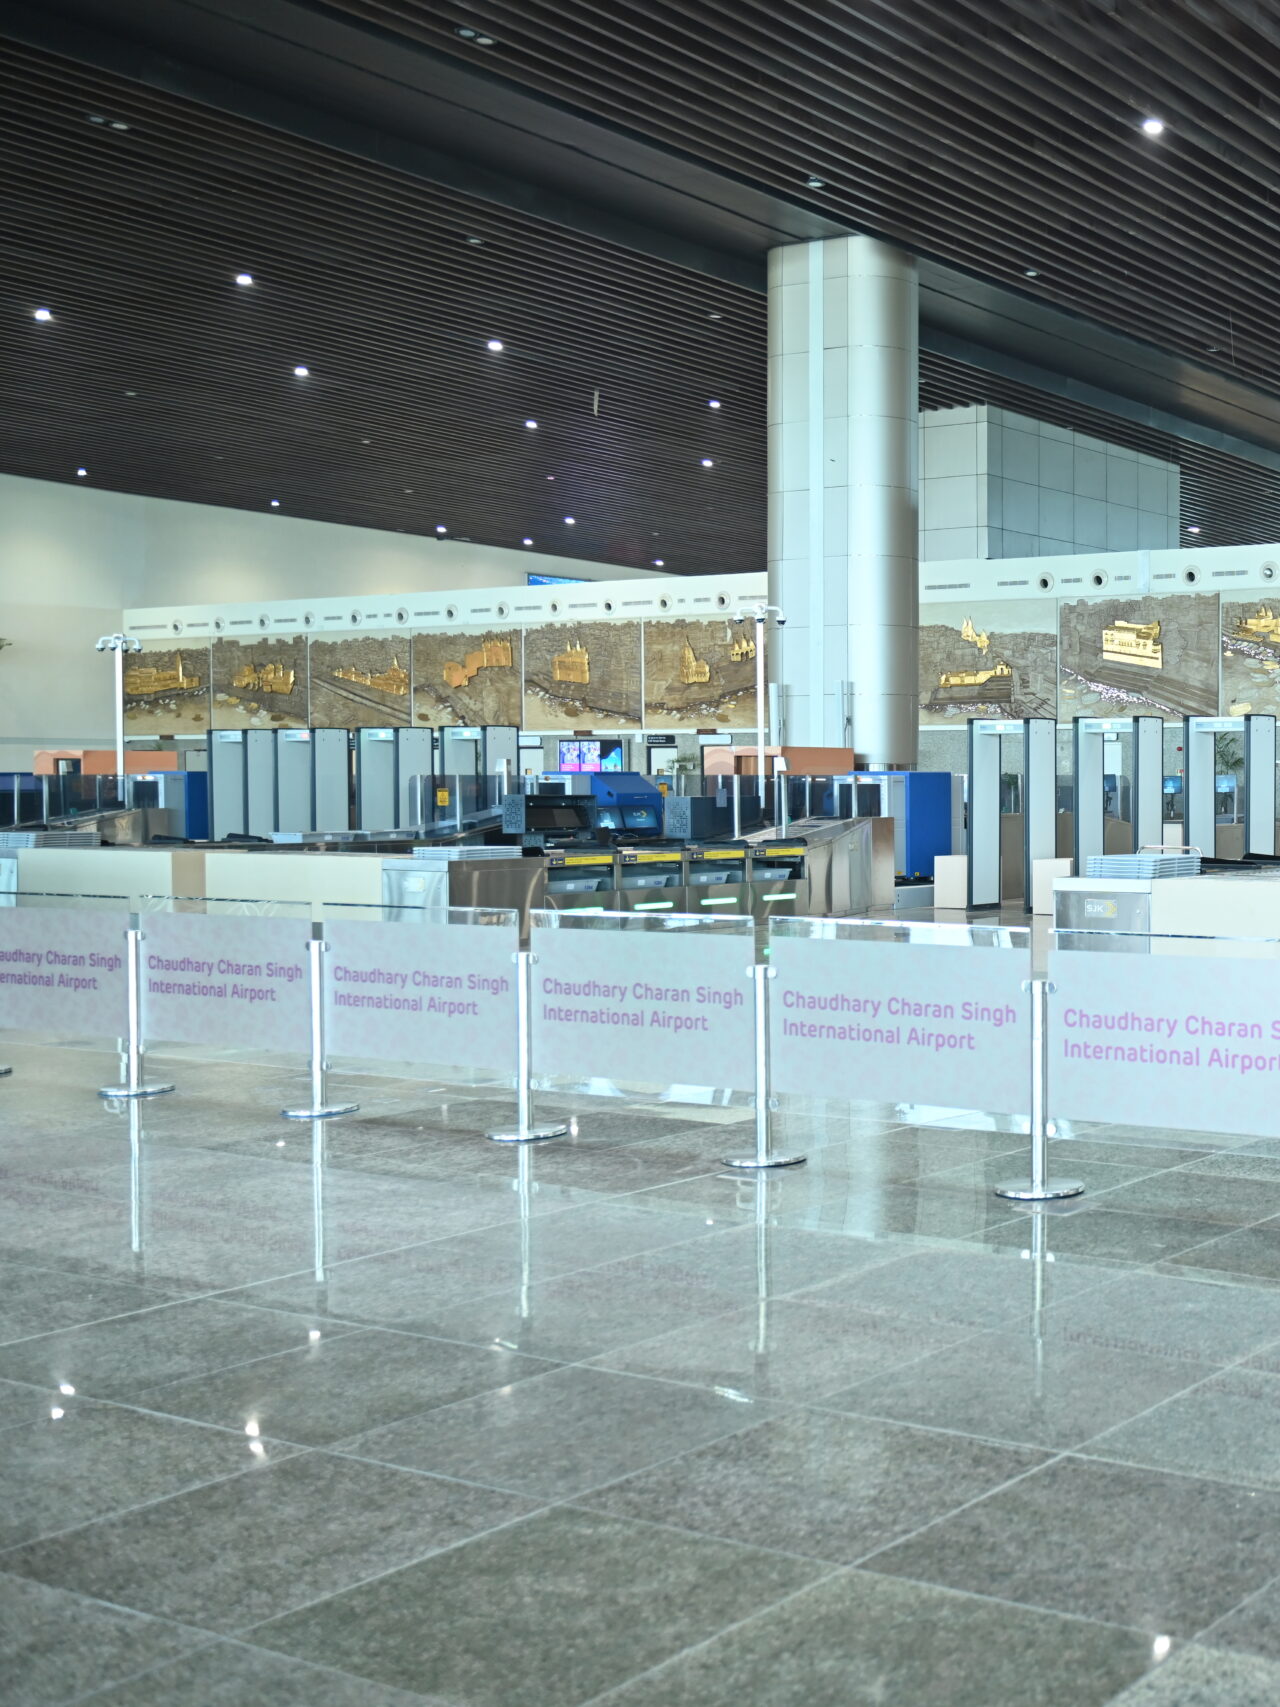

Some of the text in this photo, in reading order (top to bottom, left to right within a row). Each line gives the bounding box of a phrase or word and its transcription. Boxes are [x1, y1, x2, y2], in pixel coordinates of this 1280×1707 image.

[1086, 904, 1105, 913] SJK
[46, 950, 86, 966] Charan
[89, 953, 122, 972] Singh
[148, 955, 303, 982] Chaudhary Charan Singh
[57, 974, 98, 992] Airport
[148, 978, 276, 1003] International Airport
[333, 966, 509, 996] Chaudhary Charan Singh
[542, 977, 744, 1009] Chaudhary Charan Singh
[333, 990, 478, 1017] International Airport
[783, 990, 1017, 1027] Chaudhary Charan Singh
[543, 1004, 709, 1033] International Airport
[1063, 1008, 1178, 1038] Chaudhary
[1184, 1015, 1263, 1039] Charan
[783, 1018, 976, 1051] International Airport
[1064, 1039, 1200, 1067] International
